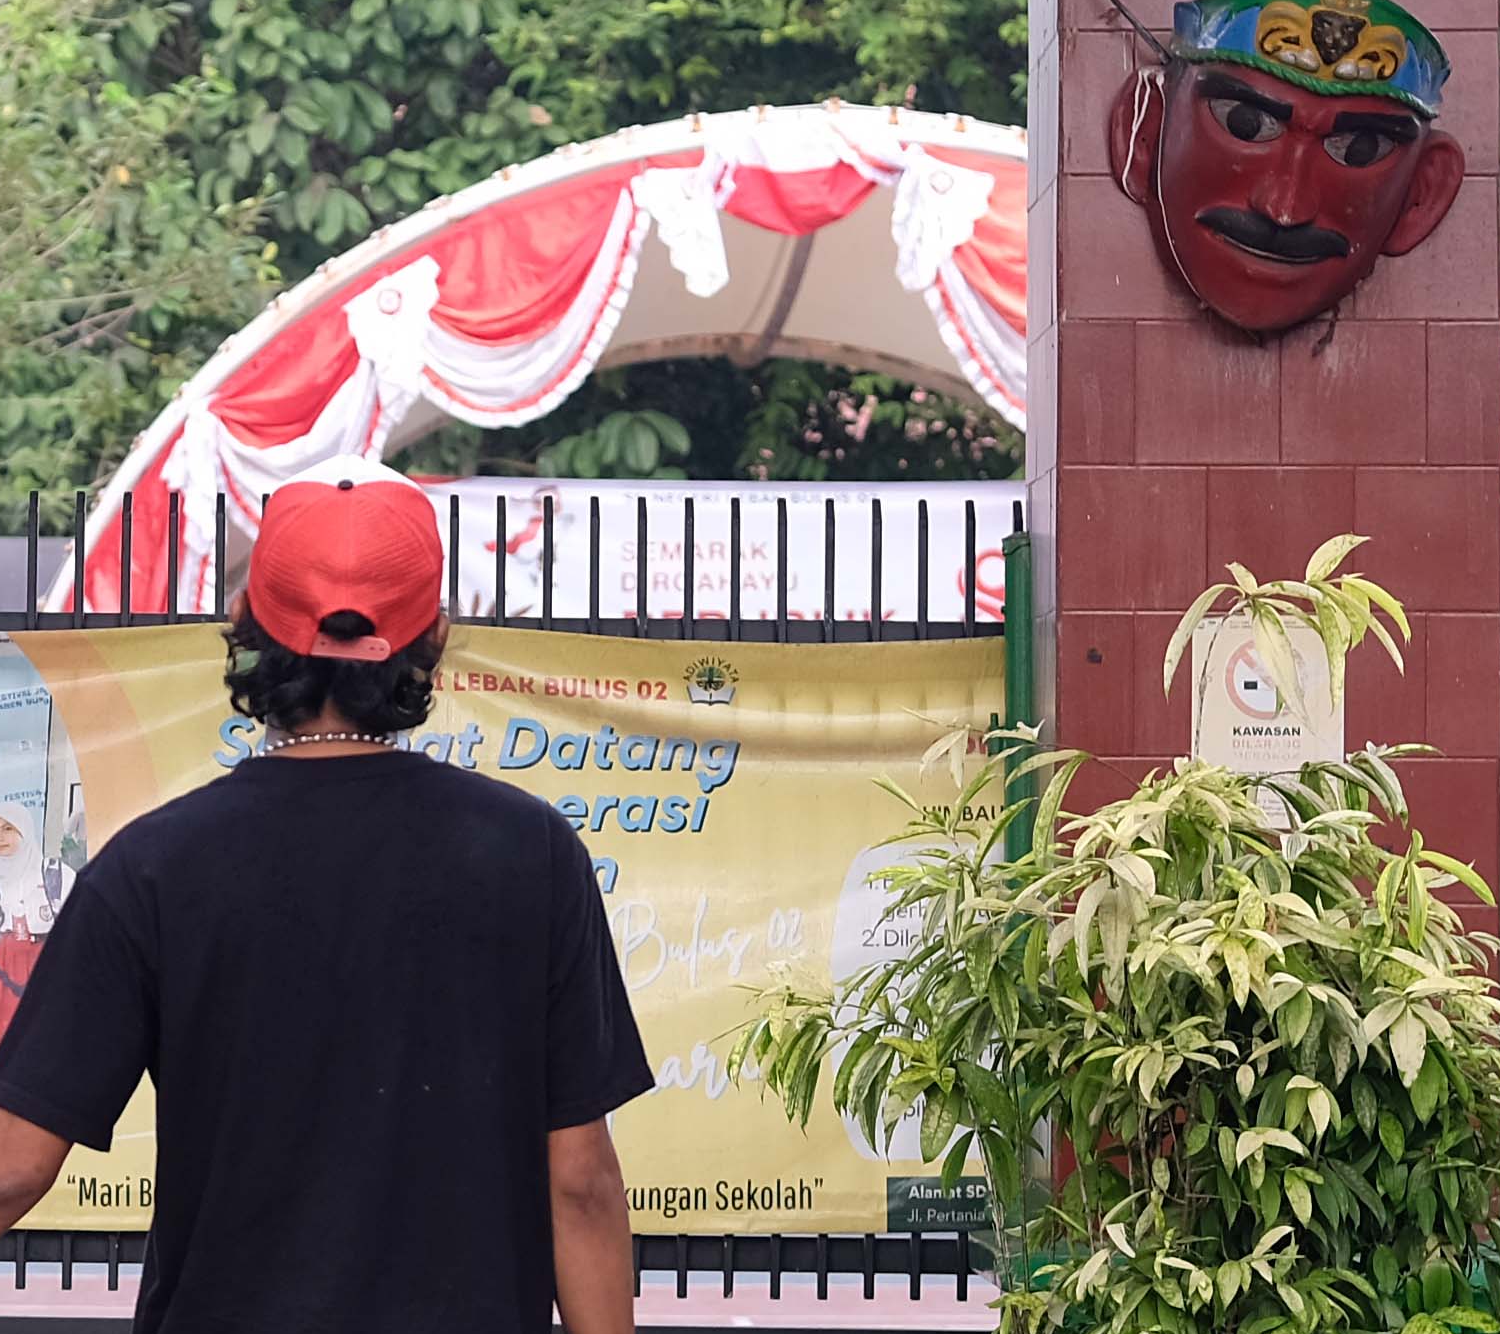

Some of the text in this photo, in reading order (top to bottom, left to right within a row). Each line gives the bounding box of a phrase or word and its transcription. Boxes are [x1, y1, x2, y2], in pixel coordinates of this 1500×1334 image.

[682, 656, 740, 684] ADIWIYATA
[453, 672, 536, 694] LEBAK
[544, 677, 628, 700] BULUS
[637, 680, 668, 701] 02
[1232, 726, 1301, 737] KAWASAN
[498, 717, 741, 792] Datang
[907, 1208, 922, 1223] Jl.
